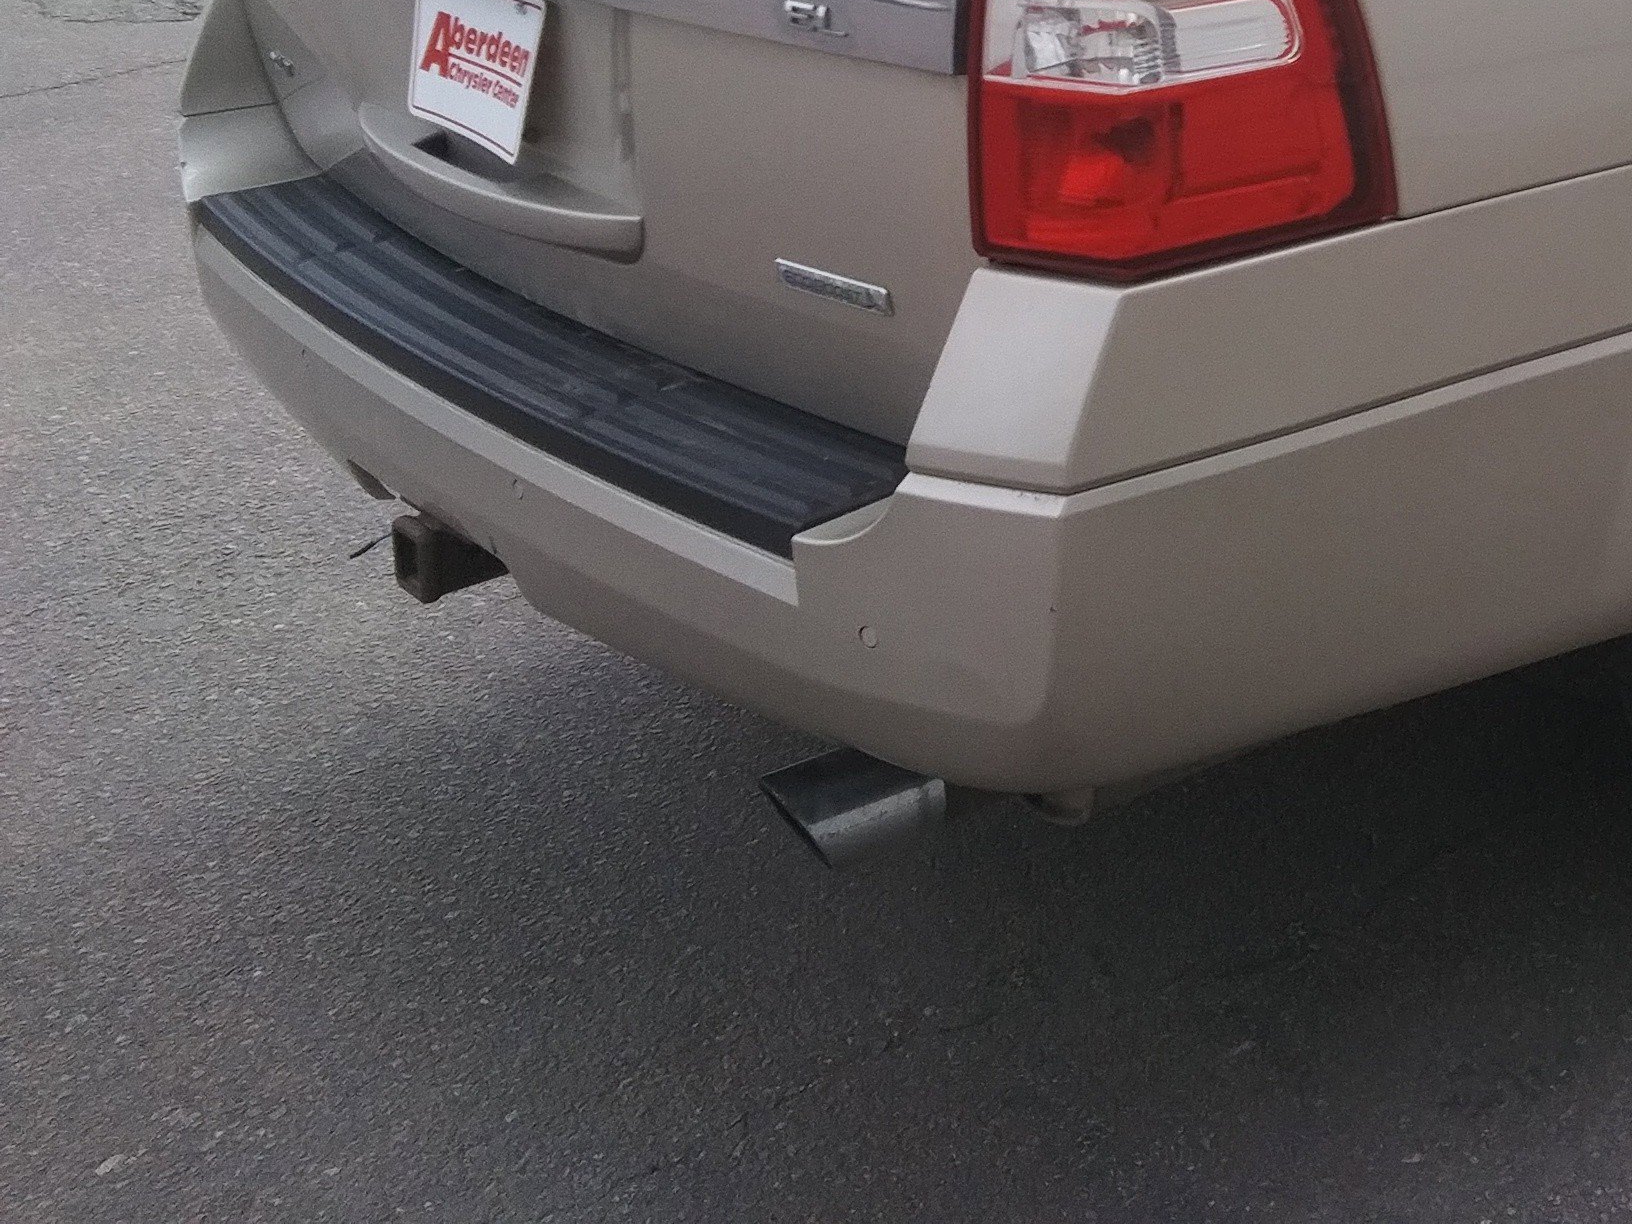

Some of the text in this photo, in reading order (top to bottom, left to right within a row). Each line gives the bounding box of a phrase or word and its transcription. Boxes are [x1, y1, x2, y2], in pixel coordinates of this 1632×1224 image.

[784, 0, 849, 37] EL
[420, 11, 530, 79] Aberdeen
[449, 62, 520, 109] Chrysler Center
